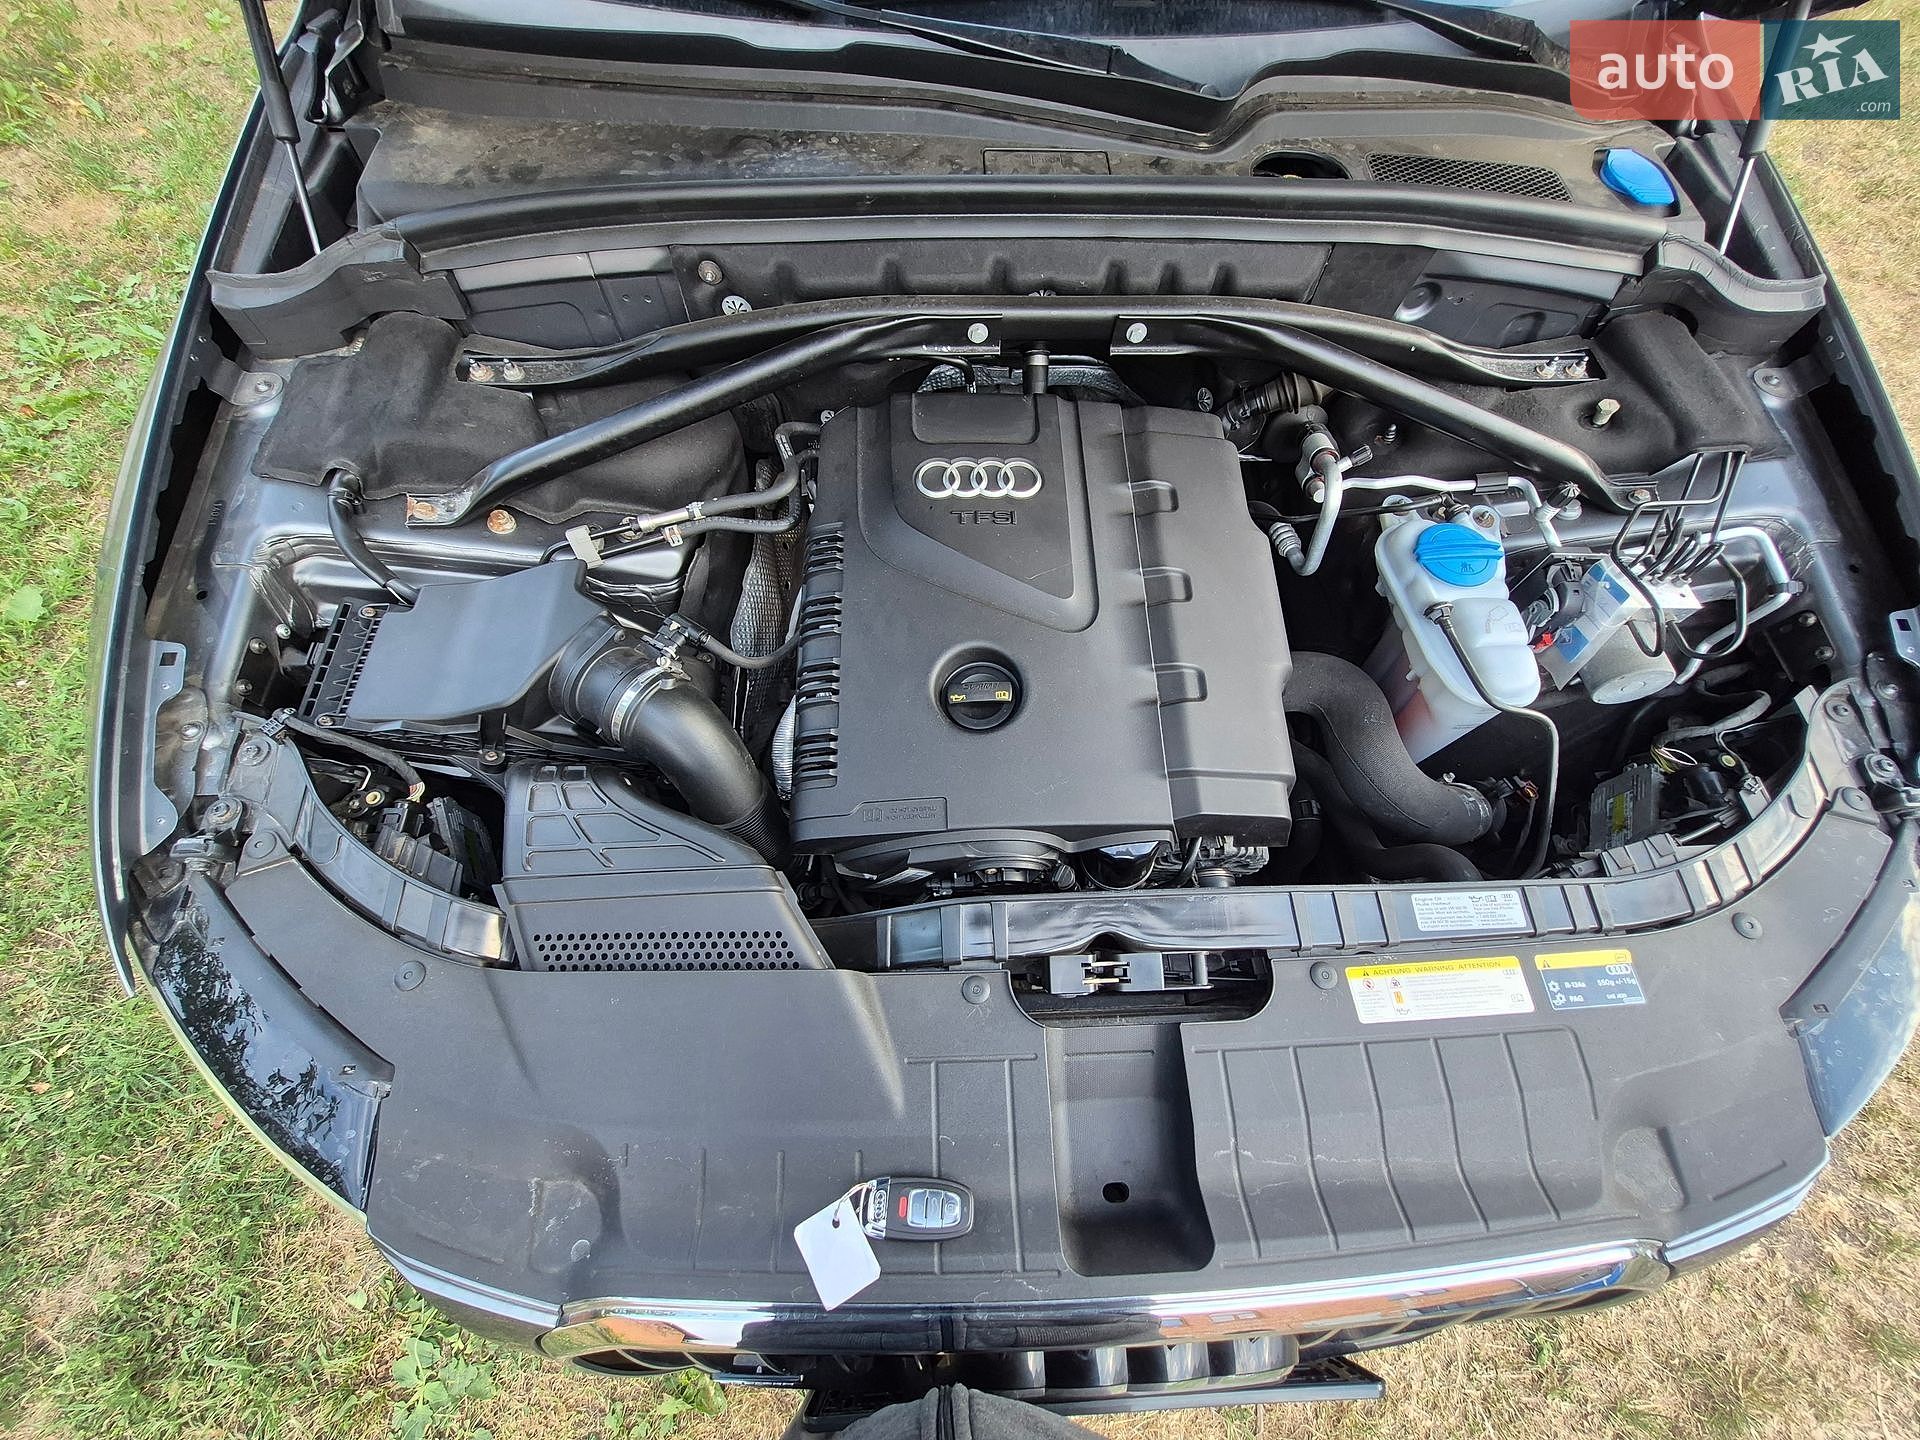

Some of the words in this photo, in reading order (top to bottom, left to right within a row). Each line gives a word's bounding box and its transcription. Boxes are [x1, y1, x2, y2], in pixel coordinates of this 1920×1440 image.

[950, 510, 1017, 525] TFSI
[1373, 967, 1411, 976] ACHTUNG
[1415, 964, 1454, 973] WARNING
[1458, 961, 1501, 970] ATTENTION
